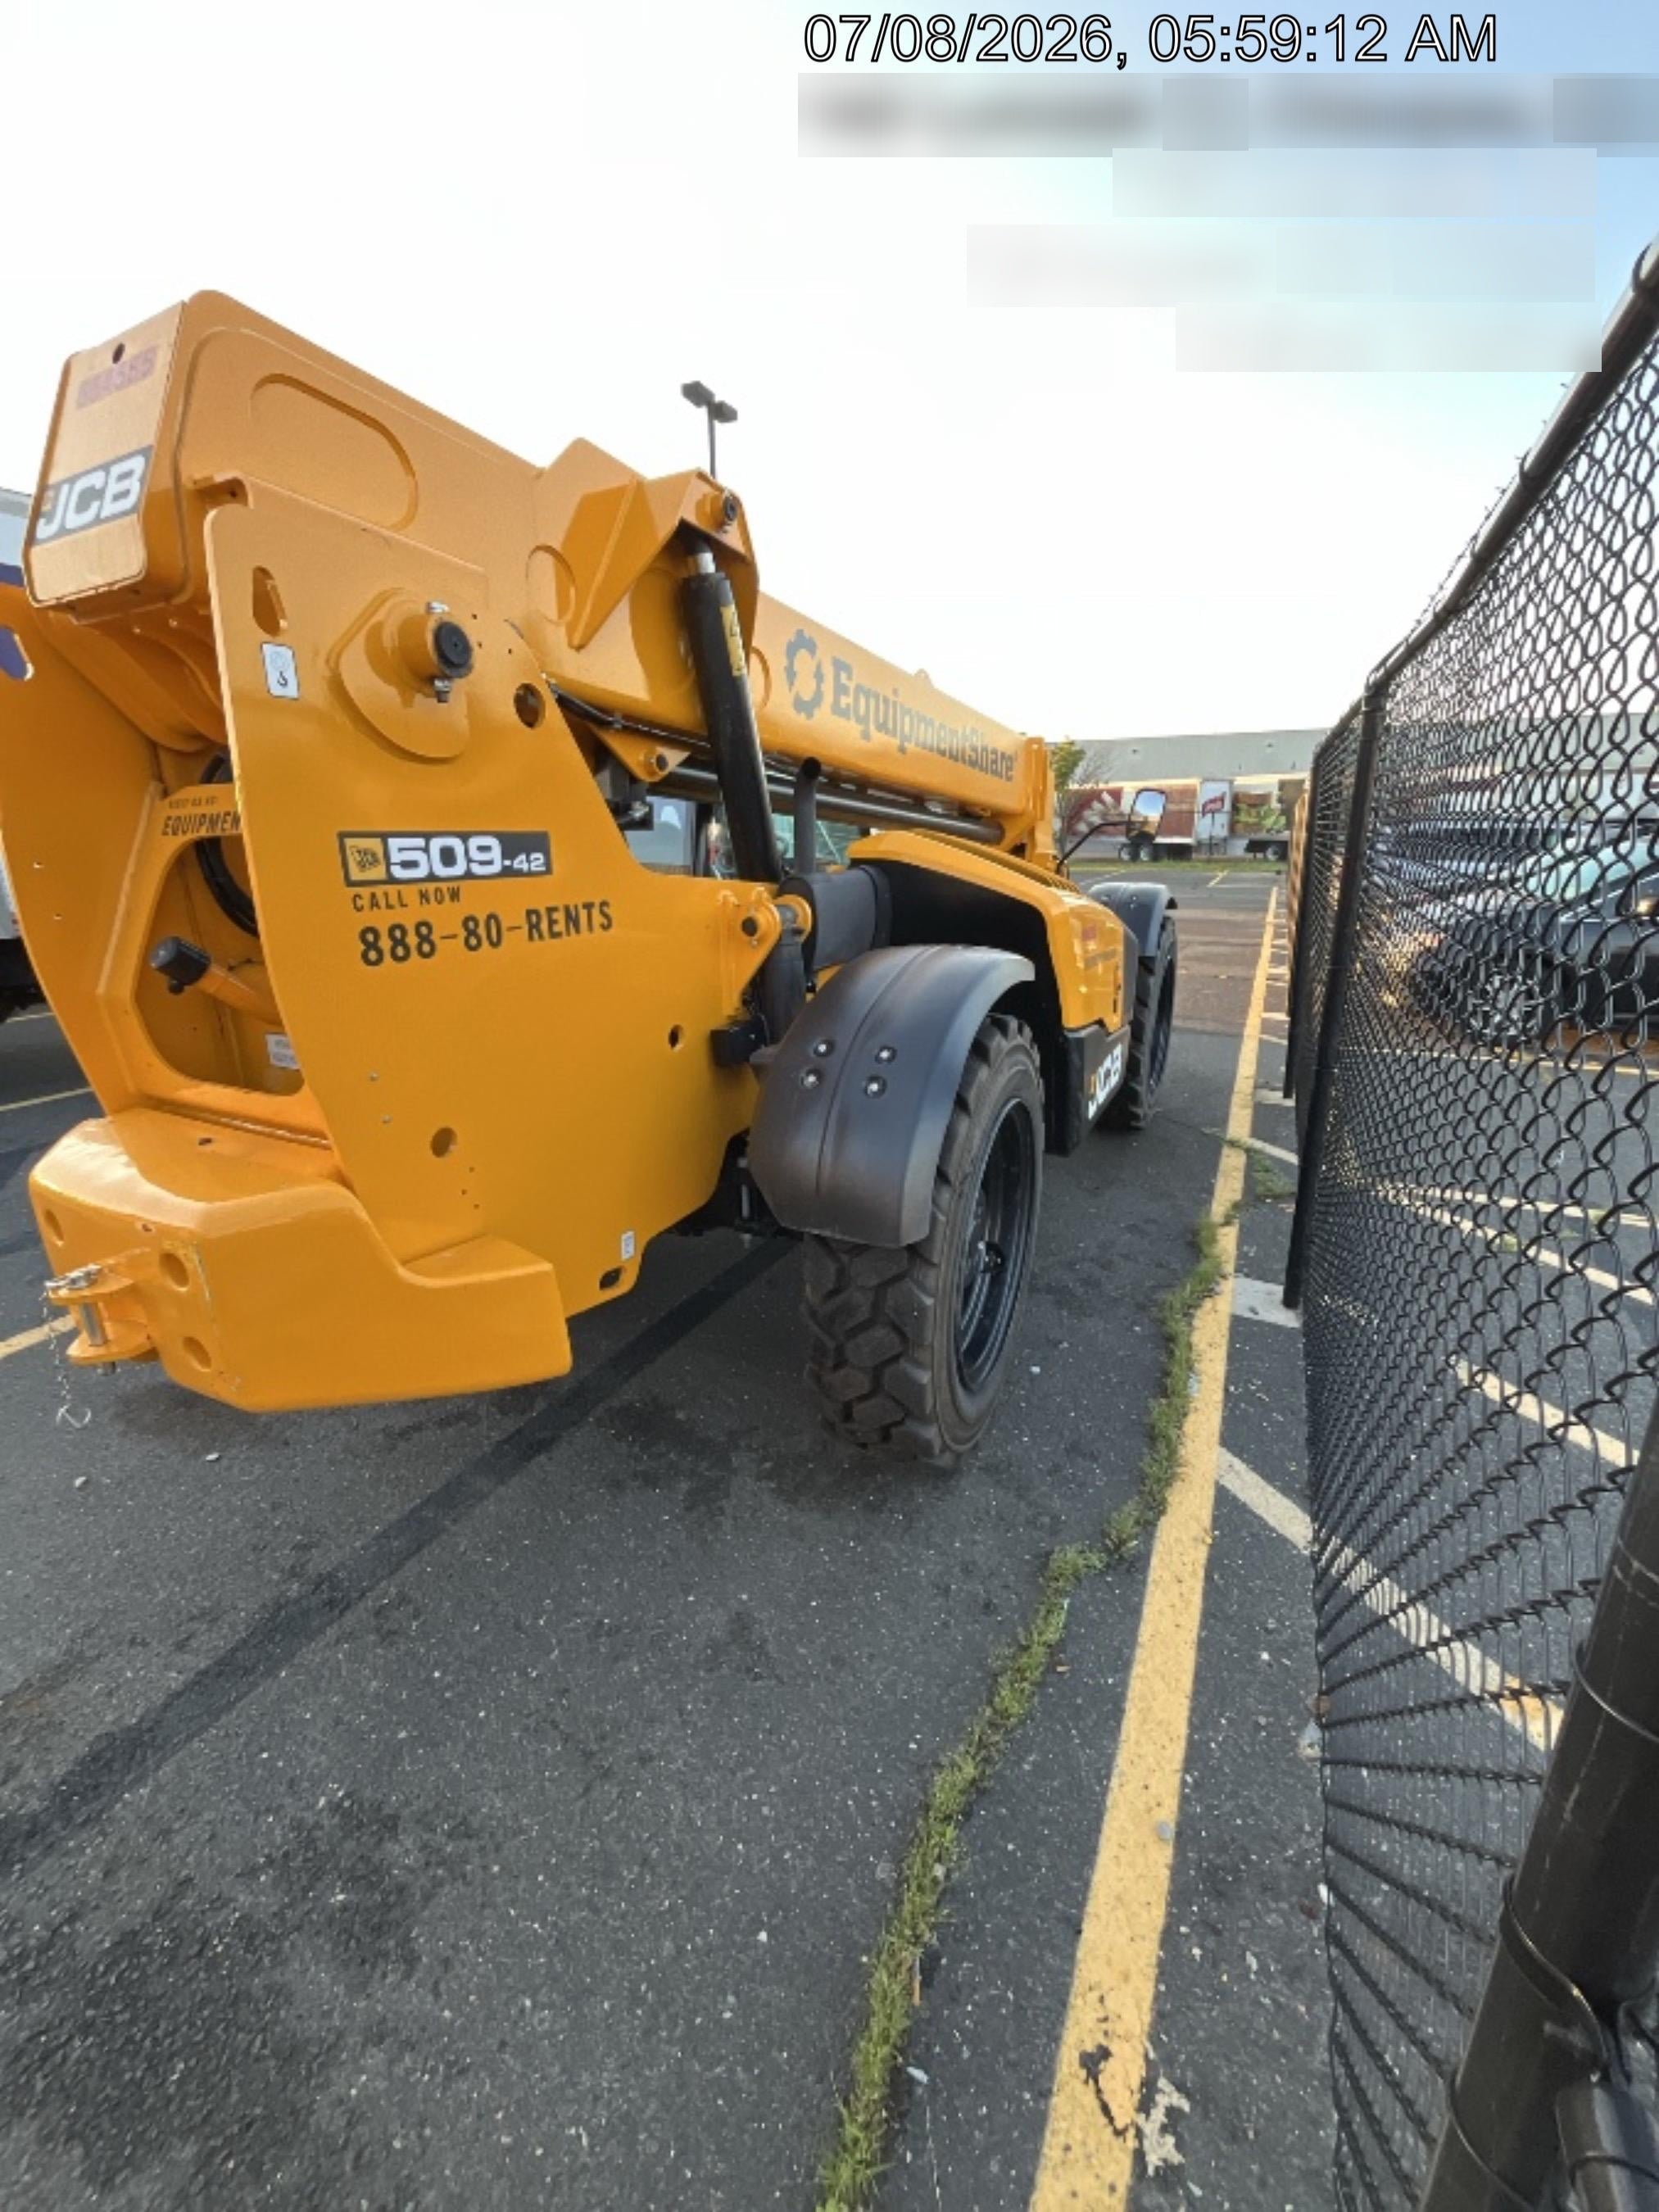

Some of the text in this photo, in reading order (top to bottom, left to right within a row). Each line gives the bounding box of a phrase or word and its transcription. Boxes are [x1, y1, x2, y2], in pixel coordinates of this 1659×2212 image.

[35, 455, 146, 540] JCB
[830, 655, 1015, 782] EquipmentShare
[161, 809, 242, 836] EQUIPMEN
[387, 835, 547, 880] 509-42
[351, 886, 461, 913] CALL NOW
[358, 900, 614, 967] 888-80-RENTS
